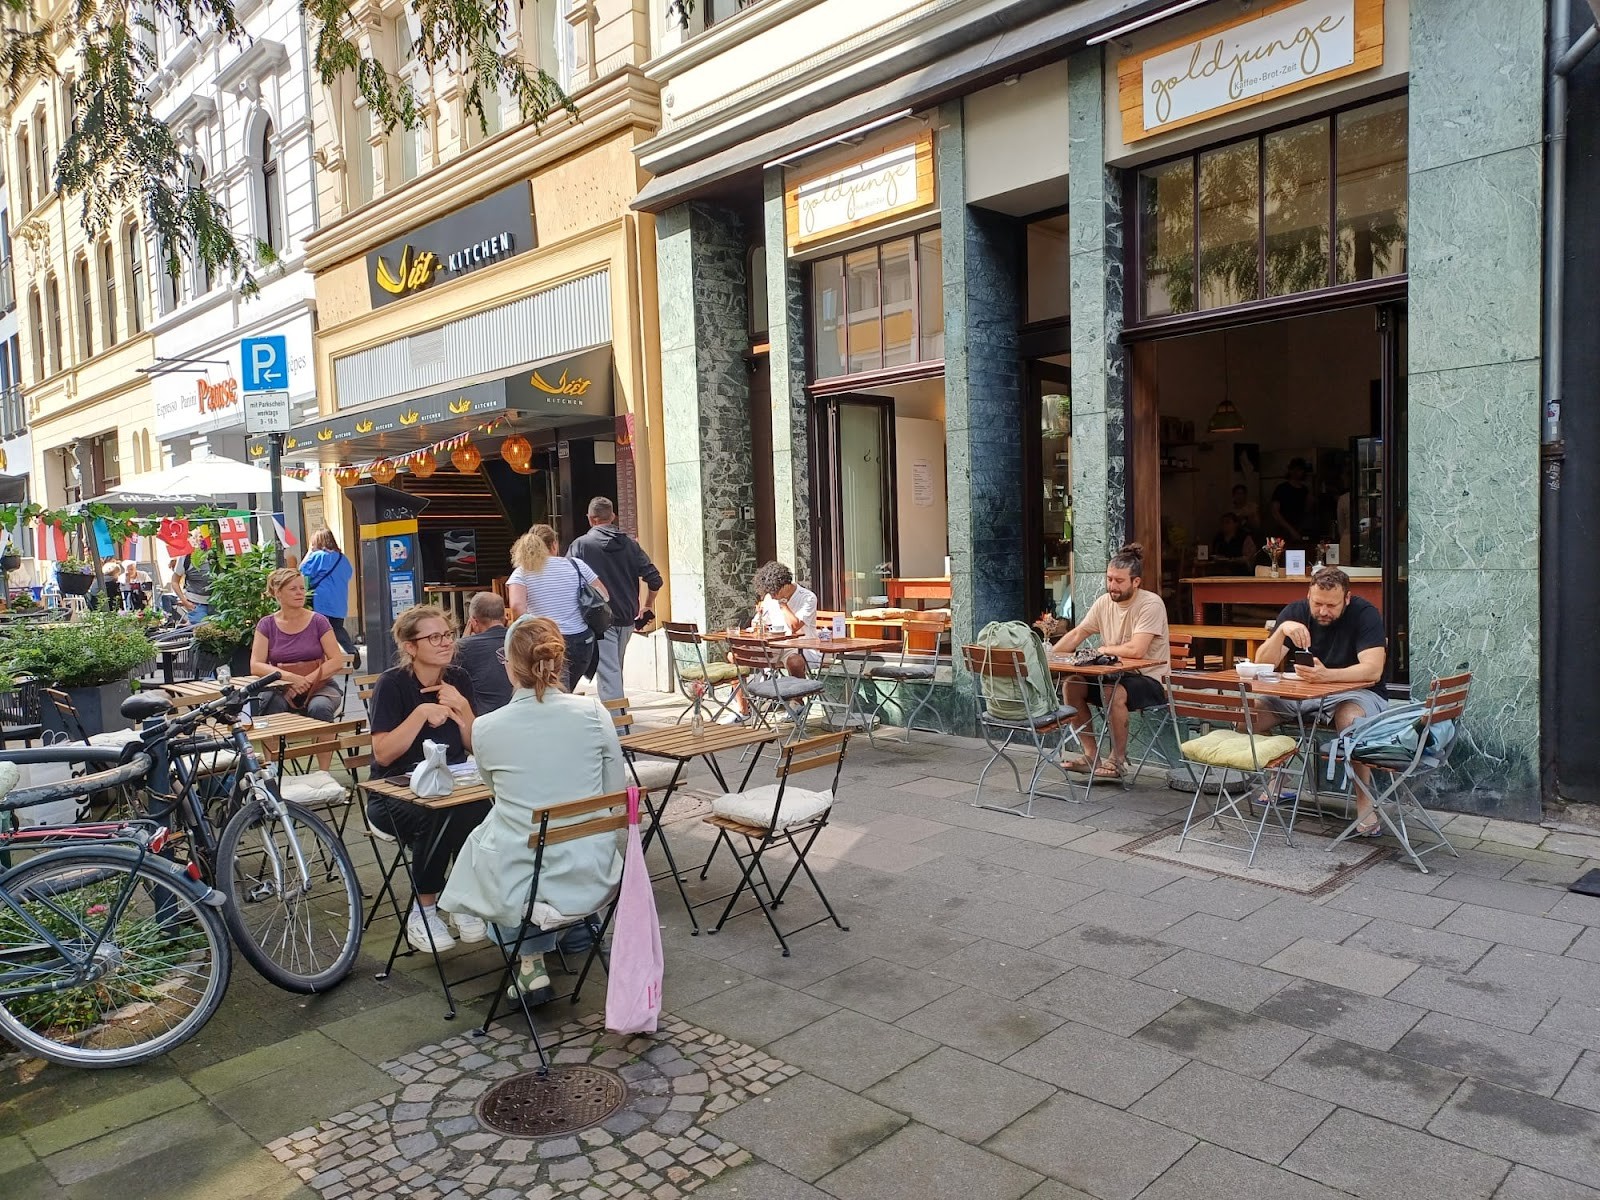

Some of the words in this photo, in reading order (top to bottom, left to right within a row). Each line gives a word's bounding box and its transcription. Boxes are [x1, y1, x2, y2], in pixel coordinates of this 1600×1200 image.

[1151, 15, 1345, 123] goldjunge
[1234, 77, 1258, 91] Kaffee
[1262, 69, 1279, 81] Brot
[1282, 62, 1297, 75] Zeit
[802, 164, 910, 233] goldjunge
[448, 231, 510, 272] KITCHEN
[251, 343, 276, 385] P
[180, 390, 197, 410] Panini
[196, 377, 239, 416] Pause
[287, 355, 307, 376] rêpes
[474, 400, 498, 411] KITCHEN
[546, 397, 584, 406] KITCHEN
